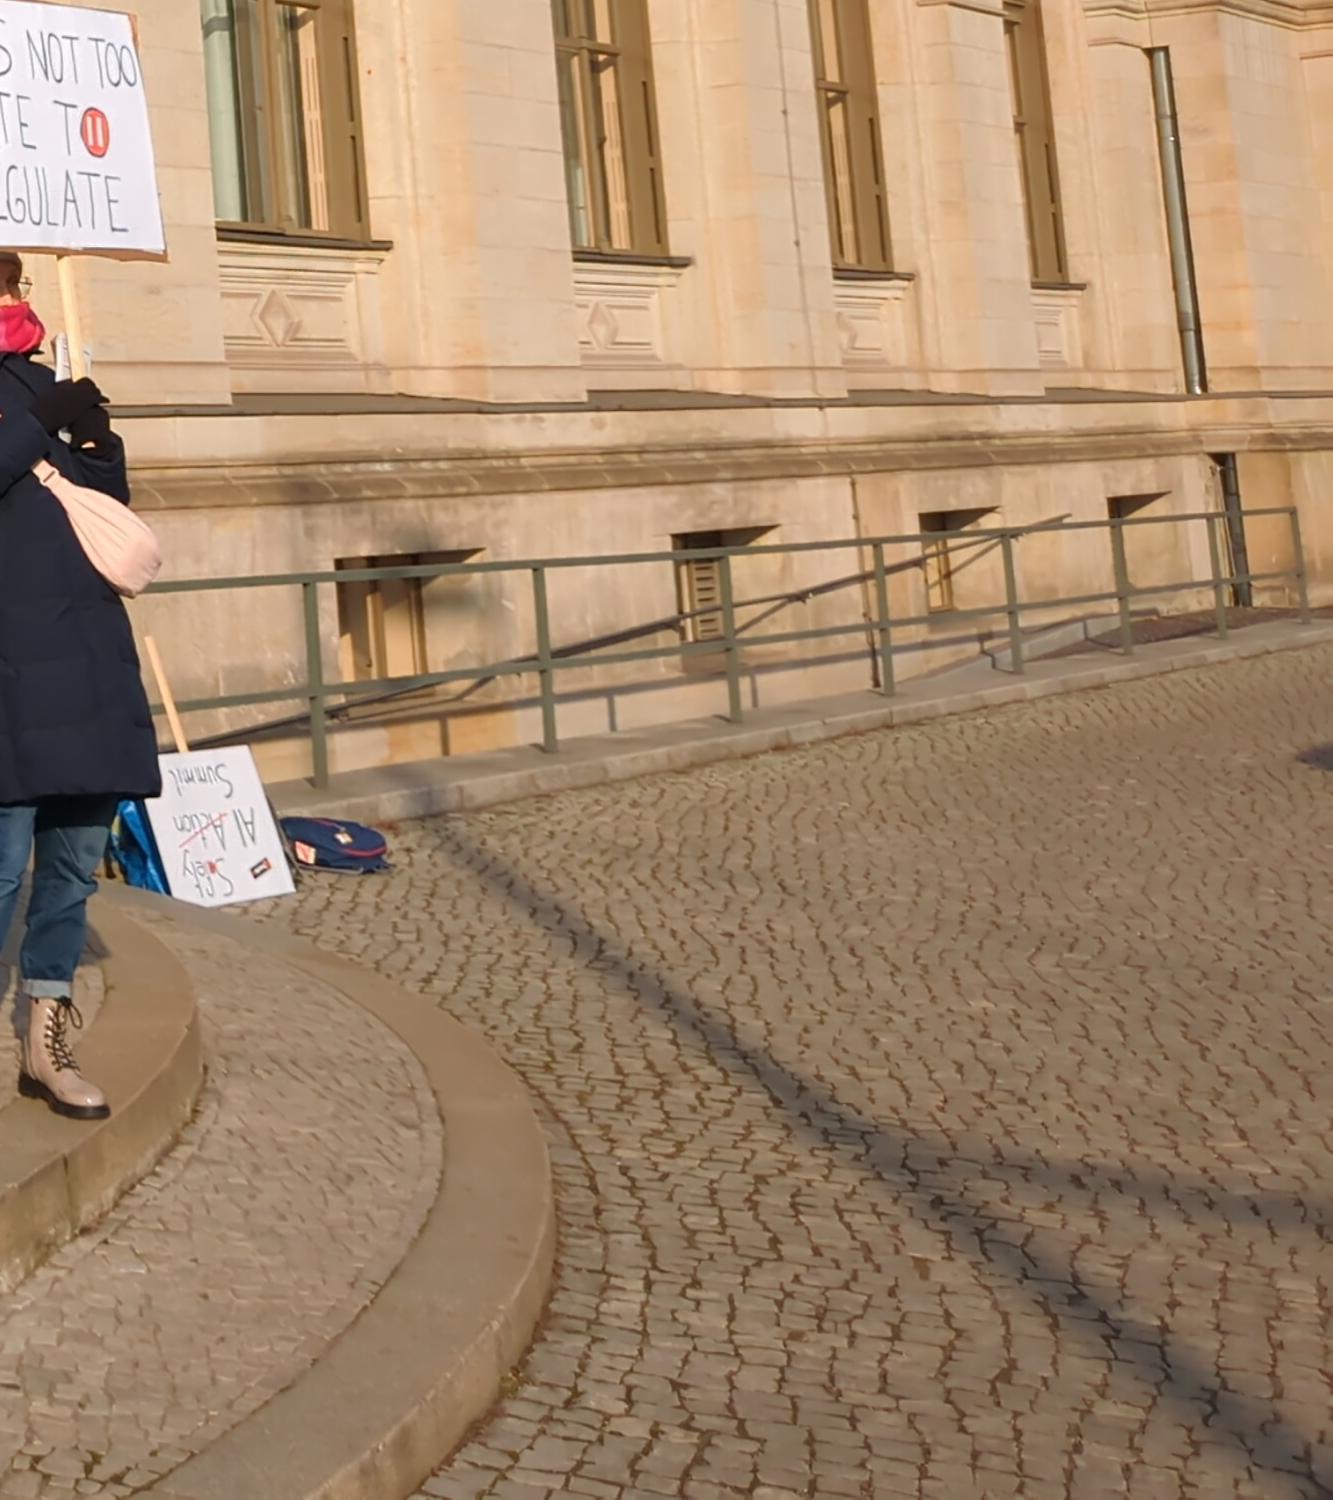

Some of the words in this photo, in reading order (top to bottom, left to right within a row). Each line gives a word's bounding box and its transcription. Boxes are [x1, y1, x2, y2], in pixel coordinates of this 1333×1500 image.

[25, 29, 80, 85] NOT
[87, 37, 137, 88] TOO
[231, 806, 257, 849] AI
